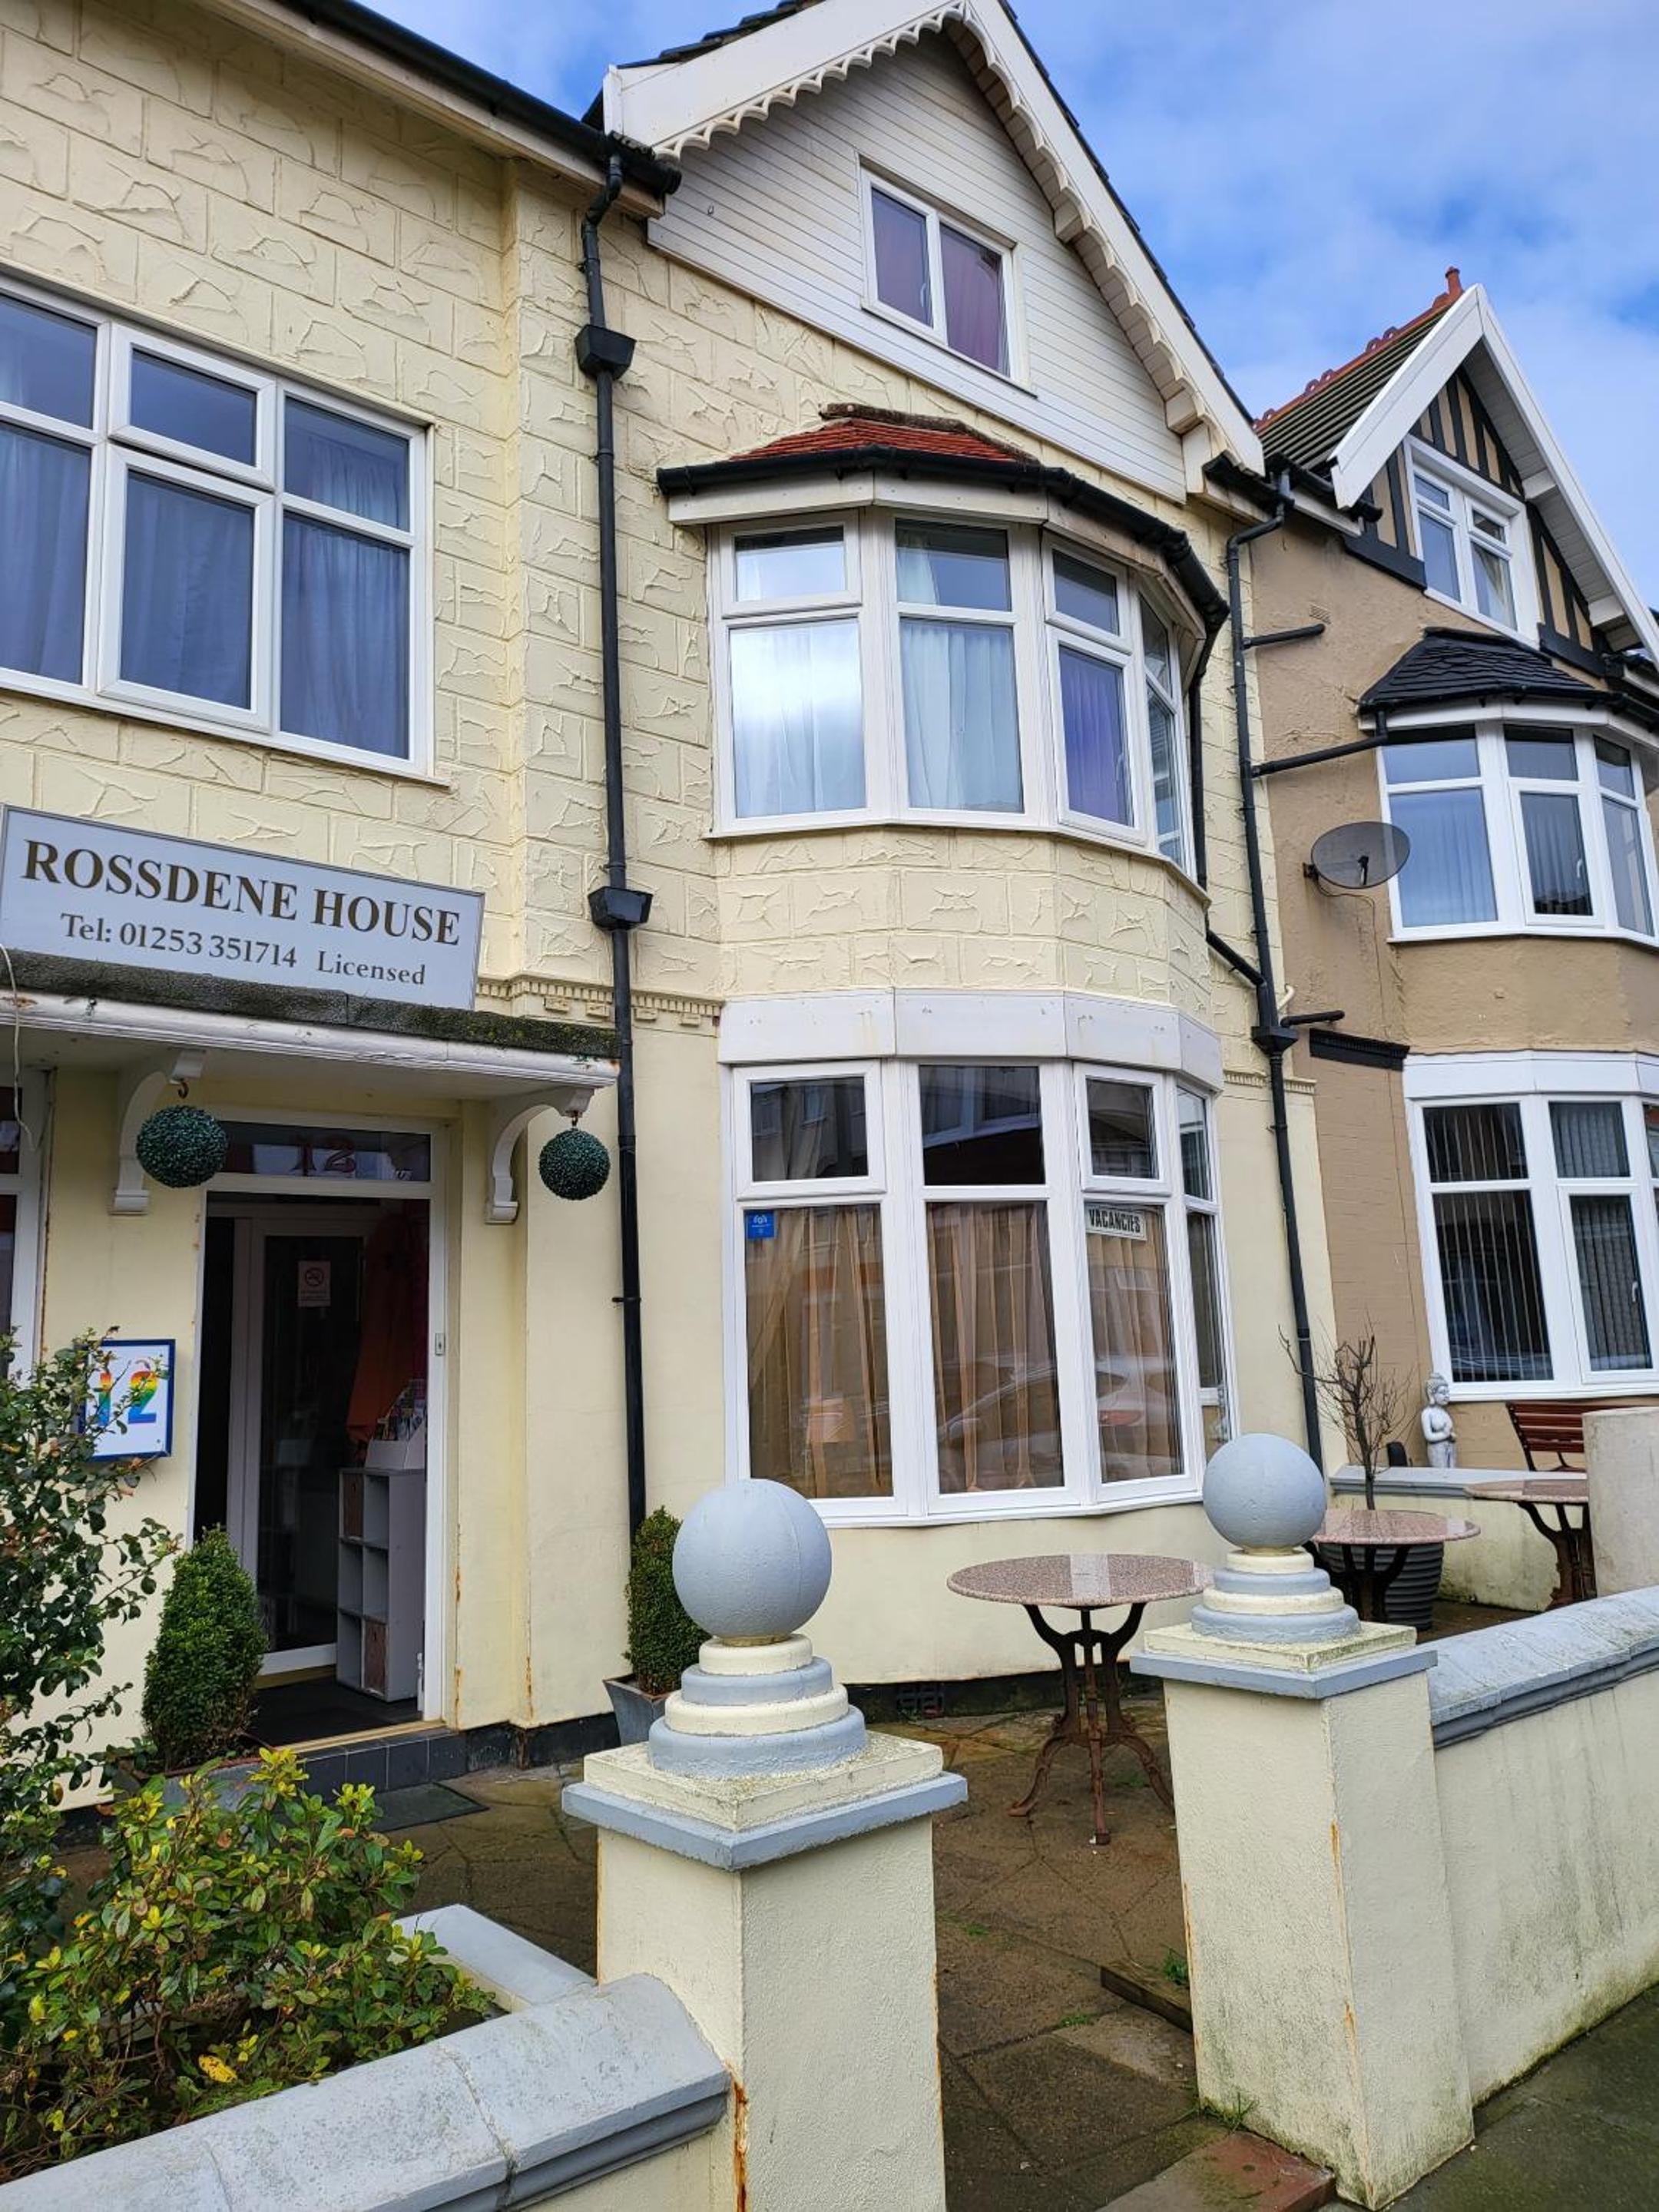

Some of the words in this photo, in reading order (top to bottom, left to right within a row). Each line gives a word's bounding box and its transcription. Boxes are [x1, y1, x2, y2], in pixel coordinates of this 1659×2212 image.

[20, 839, 297, 920] ROSSDENE
[310, 889, 460, 945] HOUSE
[60, 912, 111, 942] Tel:
[119, 922, 203, 955] 01253
[208, 934, 297, 968] 351714
[316, 950, 426, 985] Licensed
[293, 1134, 356, 1174] 12
[1089, 1208, 1141, 1233] VACANCIES
[94, 1370, 158, 1428] 12
